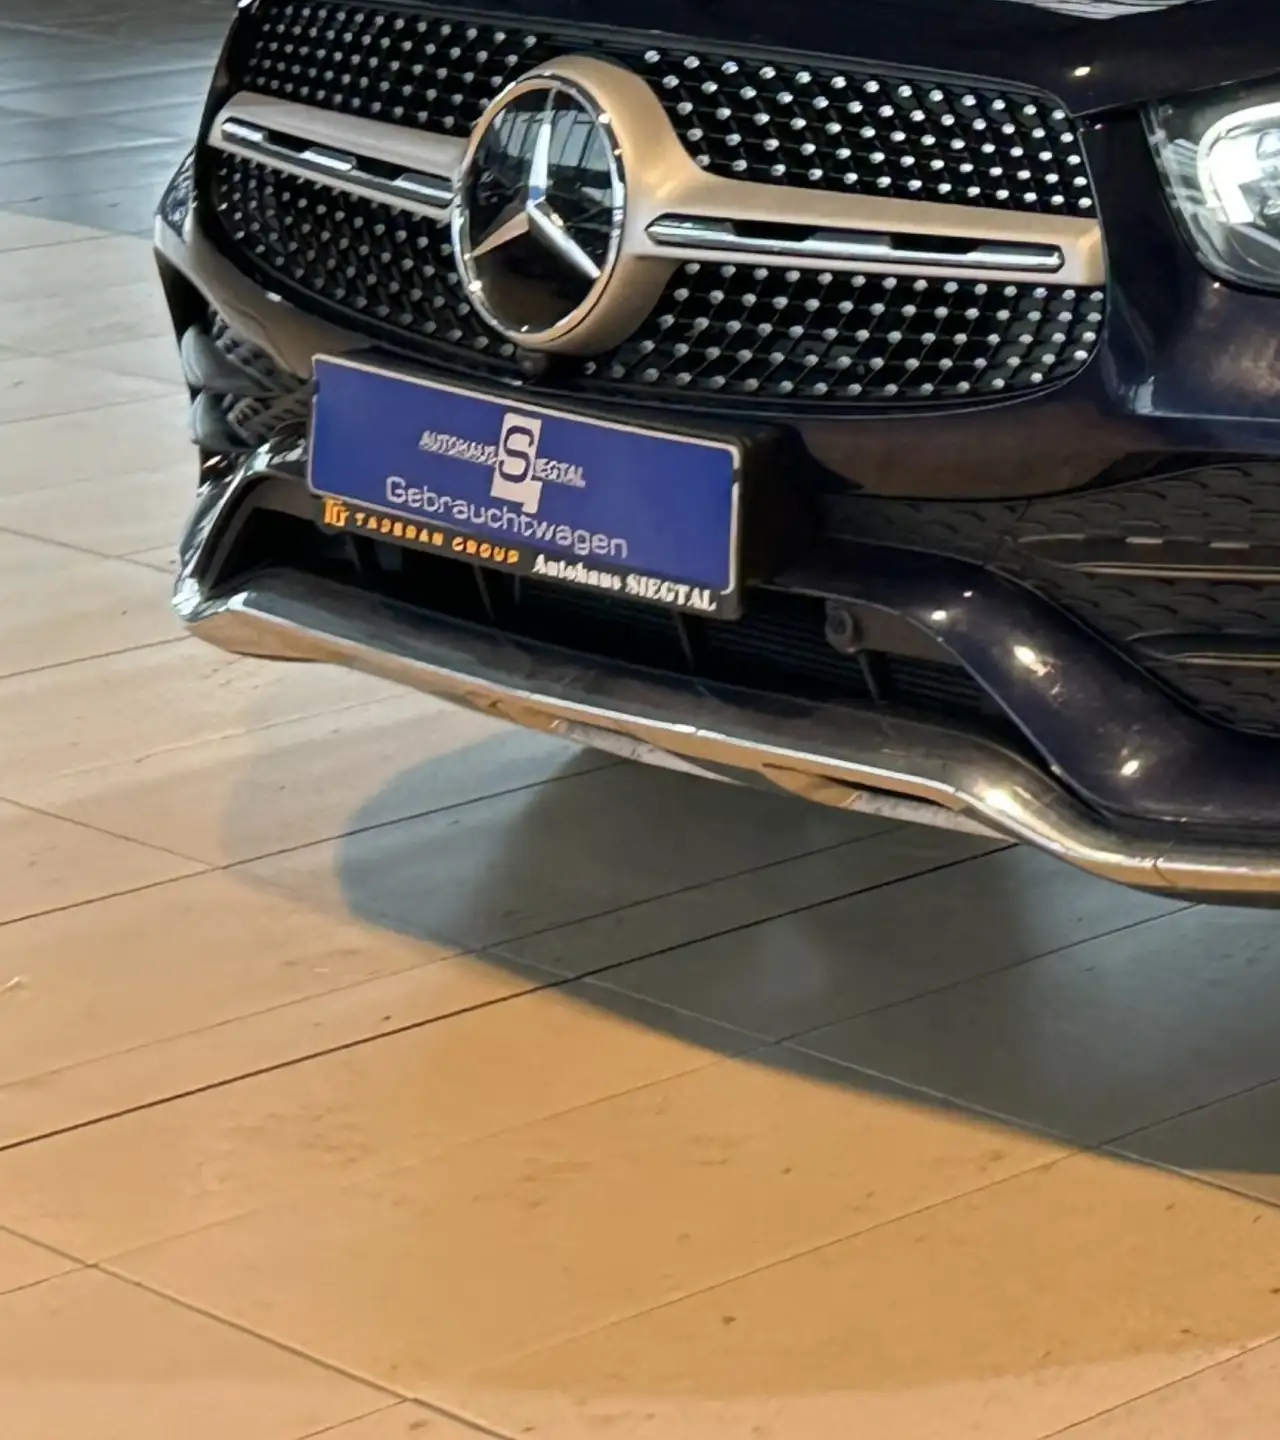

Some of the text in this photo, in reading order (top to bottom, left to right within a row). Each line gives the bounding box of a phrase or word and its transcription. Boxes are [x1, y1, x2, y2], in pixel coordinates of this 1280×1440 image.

[385, 475, 629, 559] Gebrauchtwagen
[532, 553, 718, 613] Autohaus SIEGTAL
